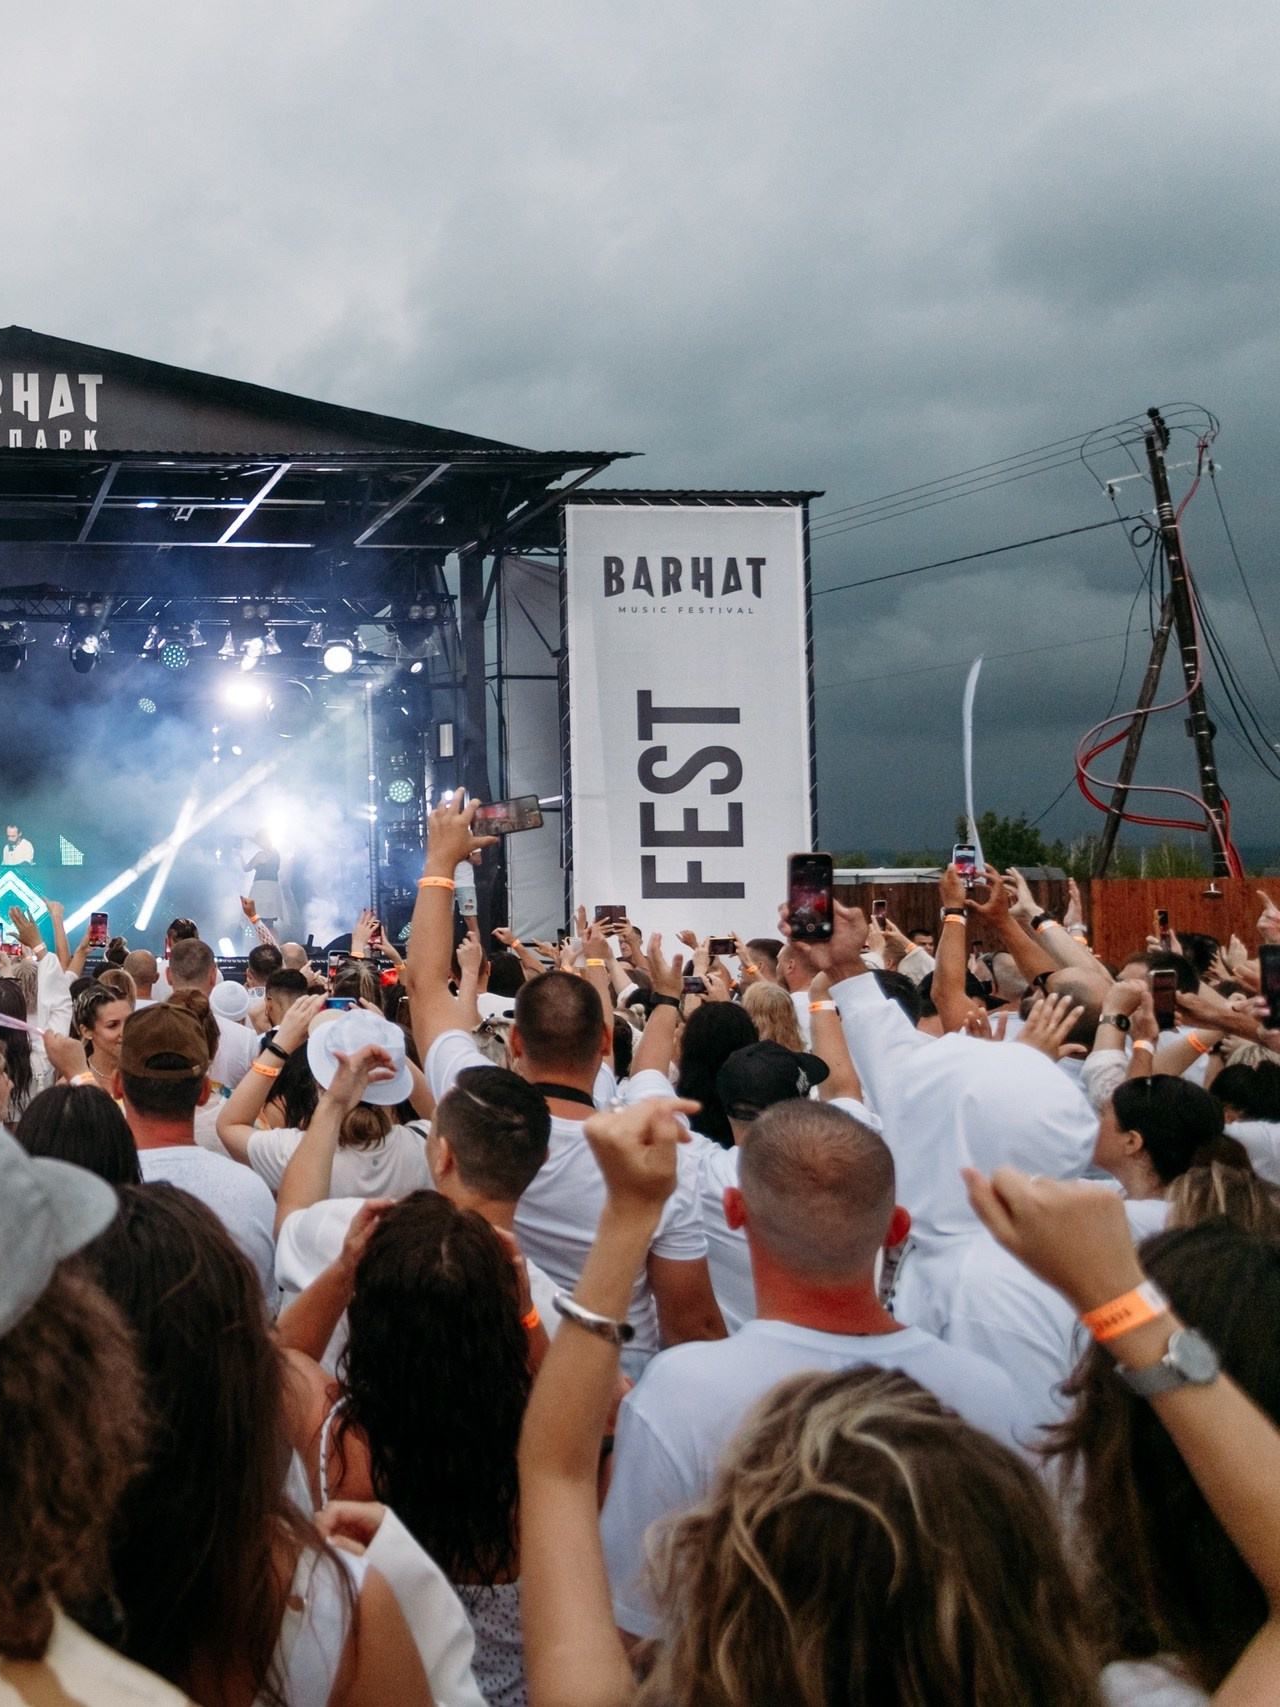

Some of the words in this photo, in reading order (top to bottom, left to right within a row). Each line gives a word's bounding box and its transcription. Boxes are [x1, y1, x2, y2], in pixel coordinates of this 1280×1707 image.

[603, 556, 767, 599] BARHAT
[618, 606, 667, 614] MUSIC
[678, 606, 754, 615] FESTIVAL
[637, 690, 746, 899] FEST
